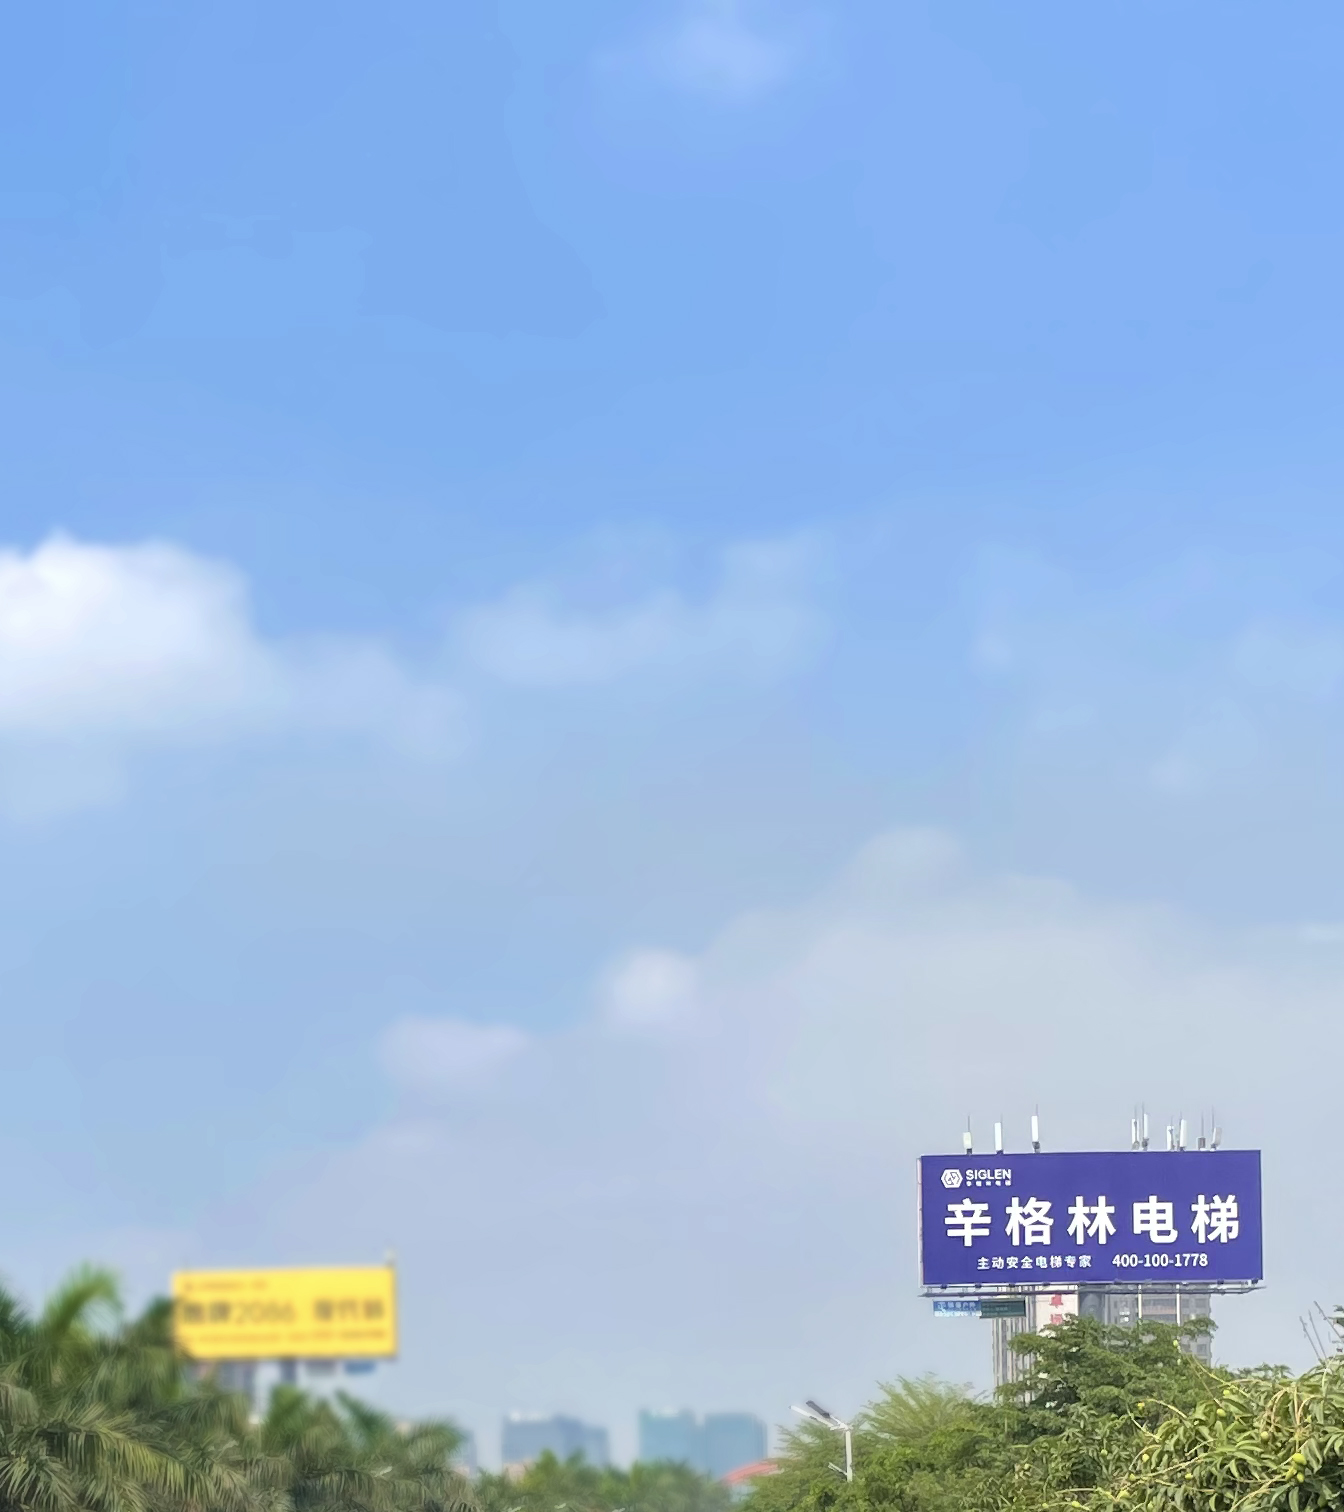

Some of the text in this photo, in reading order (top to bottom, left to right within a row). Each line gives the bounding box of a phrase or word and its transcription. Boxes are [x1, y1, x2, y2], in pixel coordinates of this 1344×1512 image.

[965, 1168, 1012, 1180] SIGLEN
[944, 1194, 1240, 1247] 辛格林电梯
[976, 1254, 1092, 1270] 主动安全电梯专家
[1111, 1252, 1209, 1268] 400-100-1778
